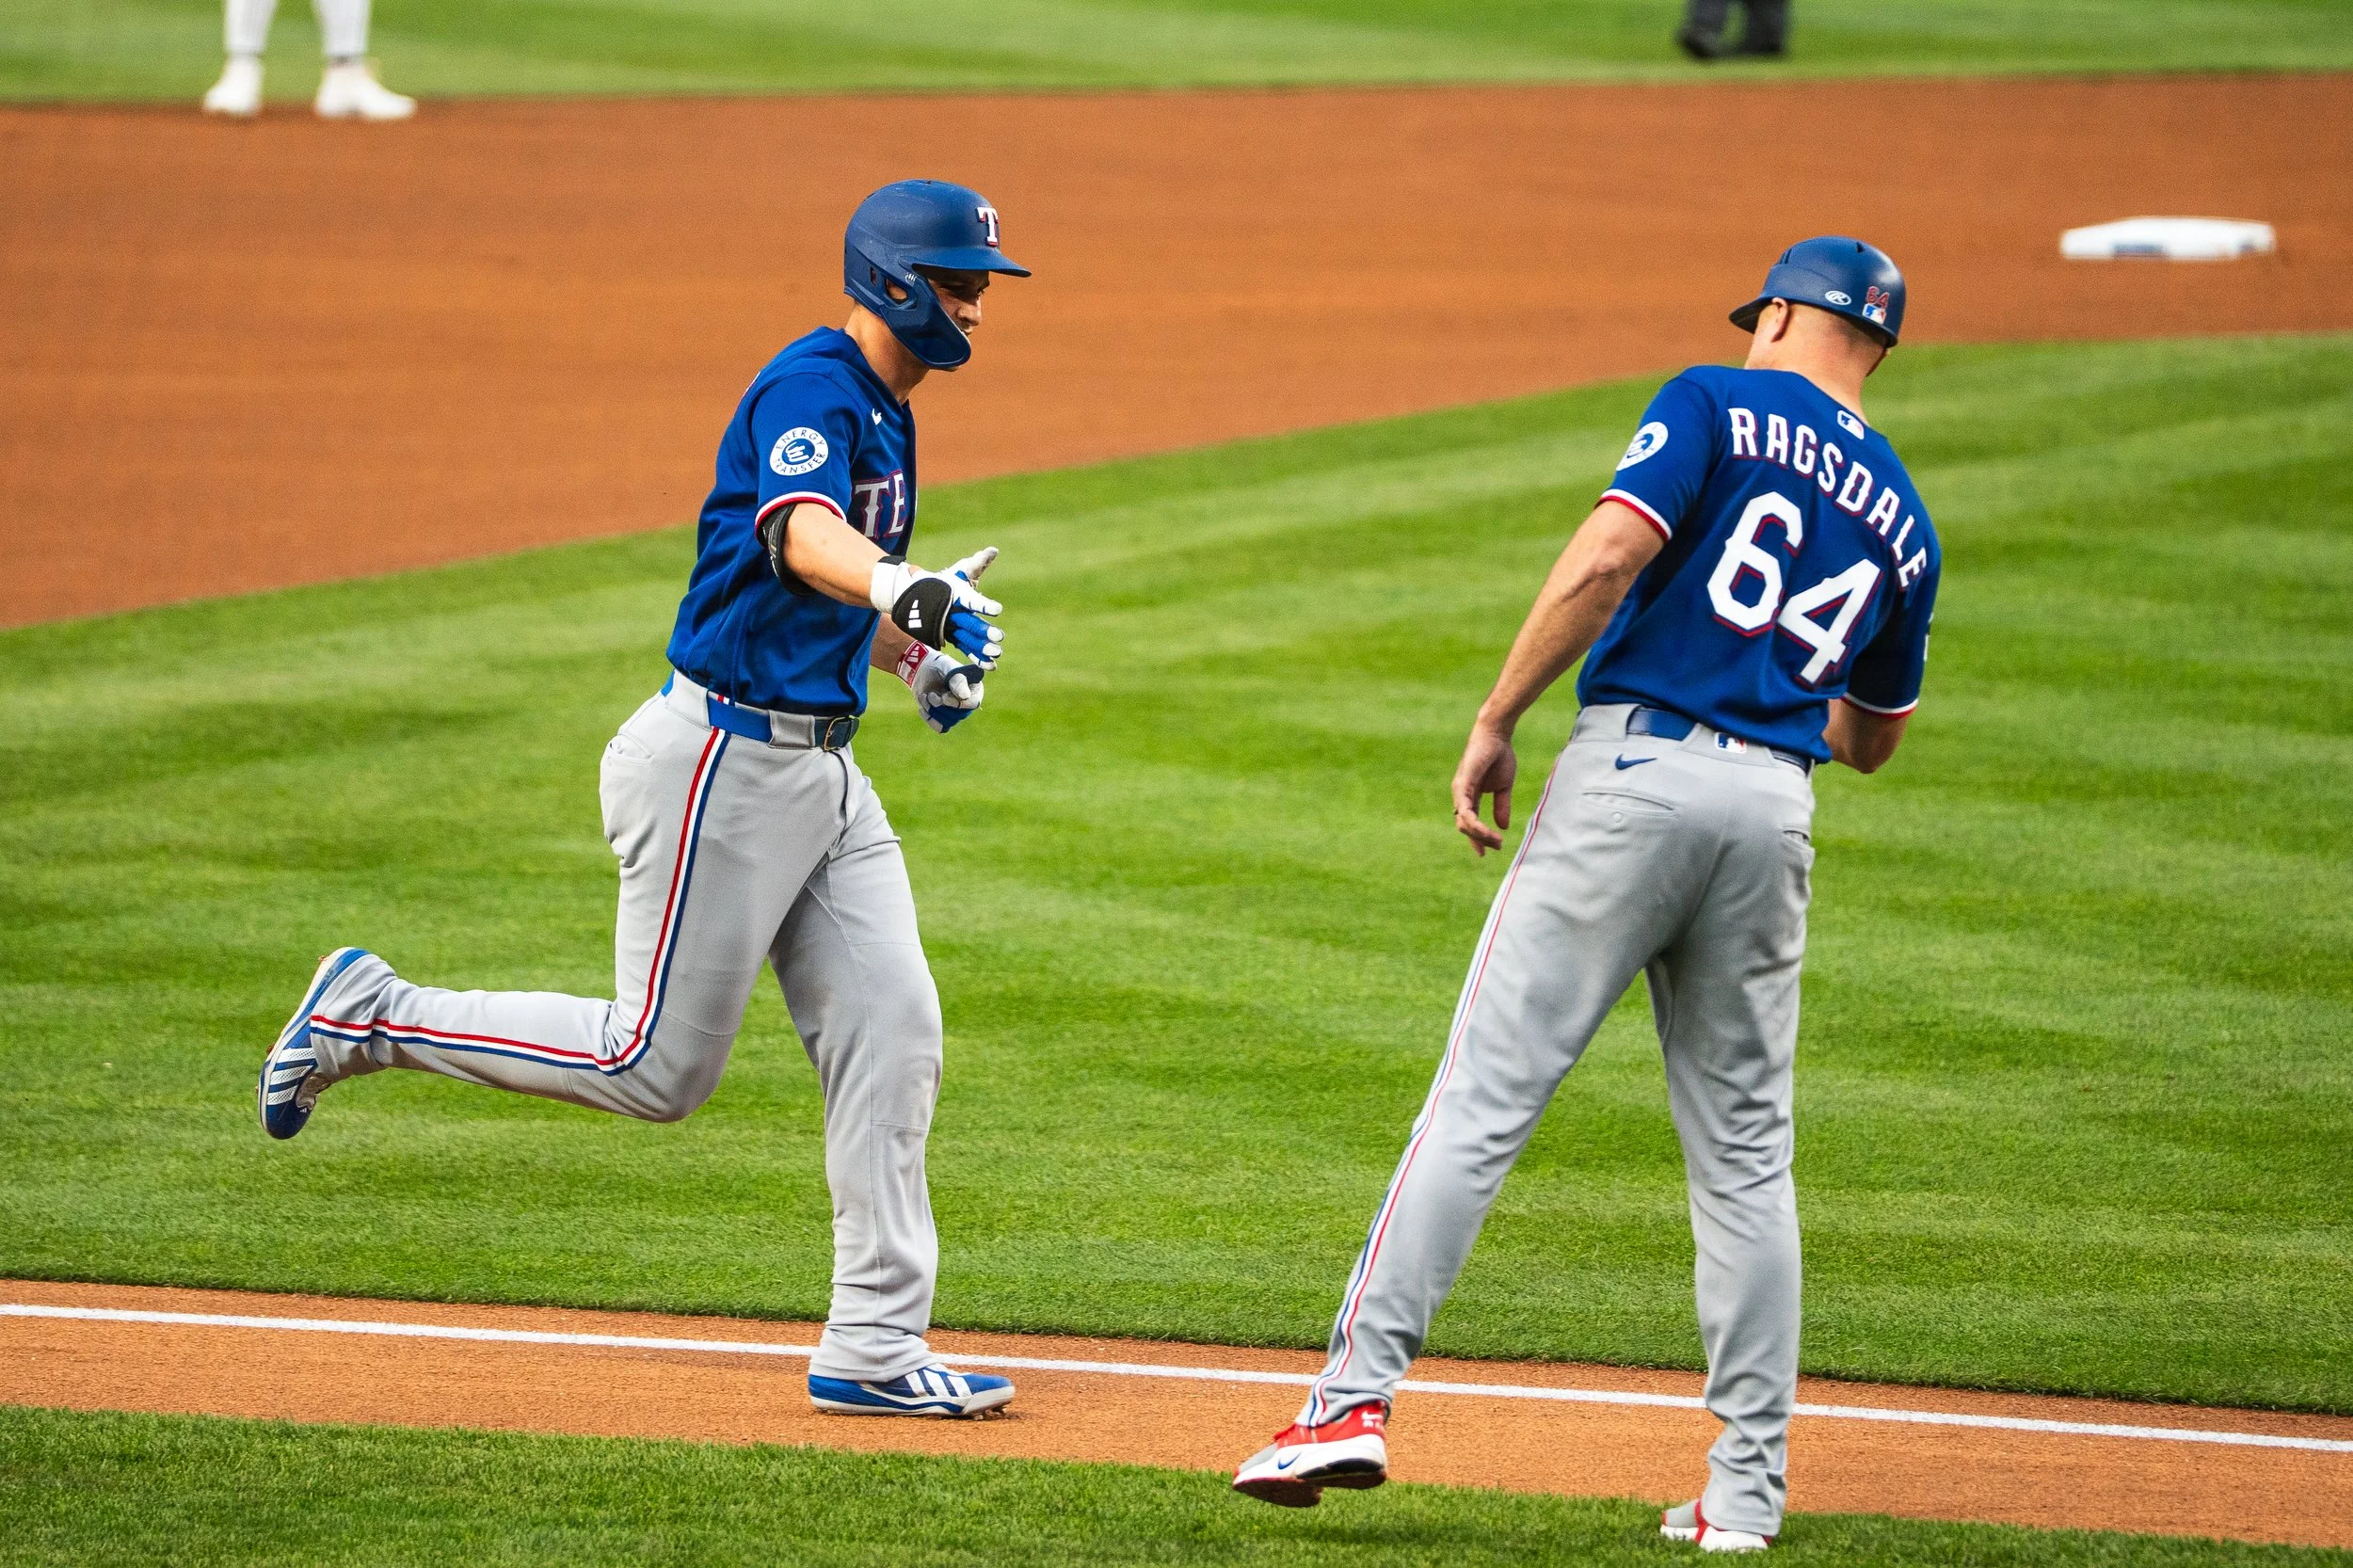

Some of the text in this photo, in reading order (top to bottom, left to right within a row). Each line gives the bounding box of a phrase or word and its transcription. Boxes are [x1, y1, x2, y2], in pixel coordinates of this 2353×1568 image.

[976, 206, 999, 247] T
[1865, 286, 1890, 309] 64
[776, 428, 825, 450] ENERGY
[773, 452, 827, 473] TRANSFER
[1728, 408, 1927, 590] RAGSDALE
[1706, 491, 1882, 691] 64
